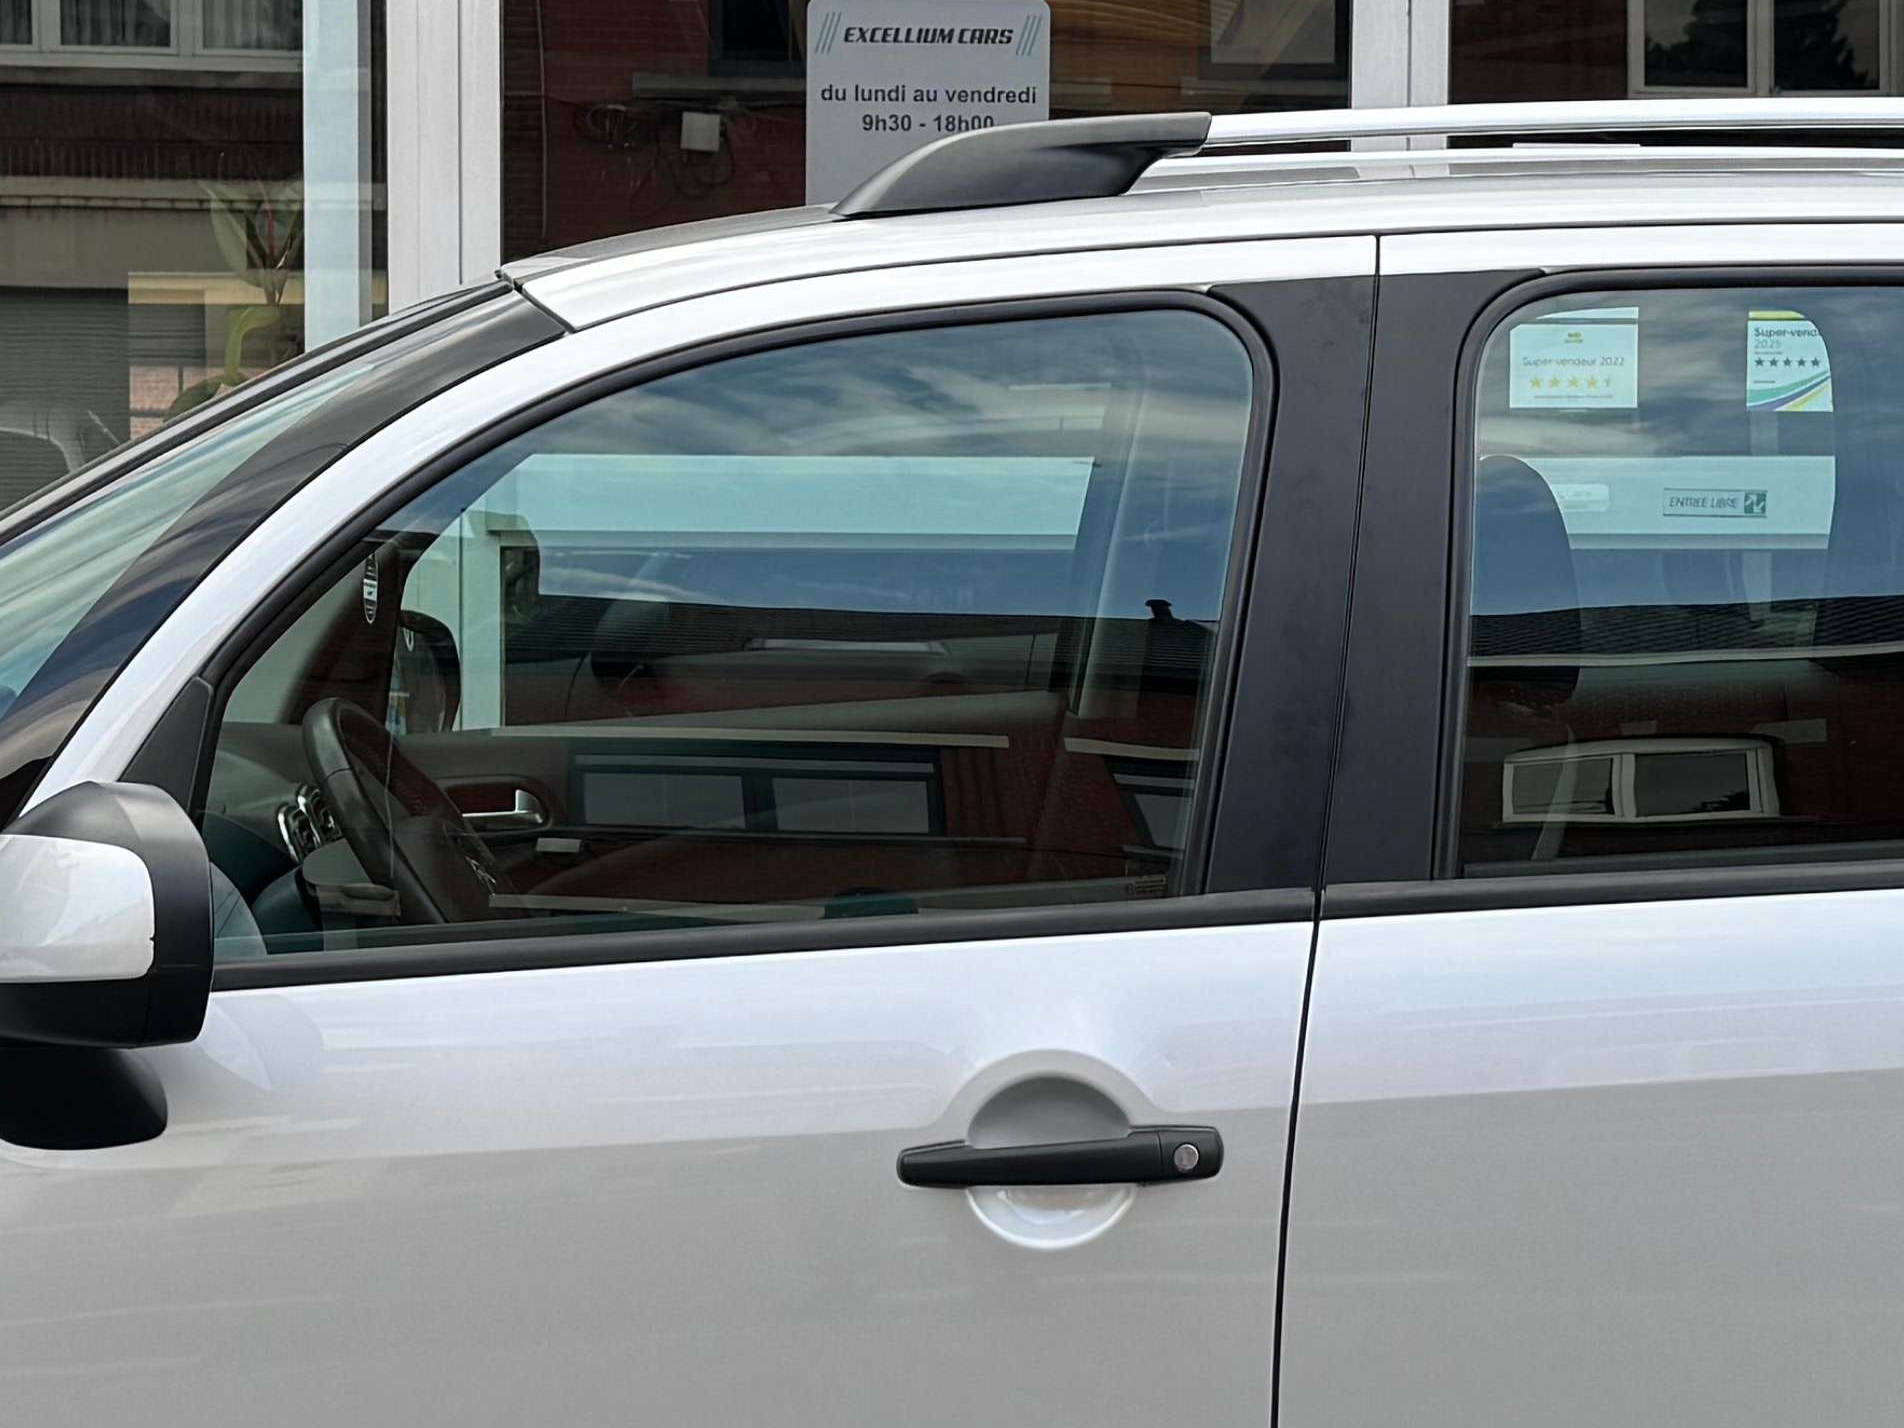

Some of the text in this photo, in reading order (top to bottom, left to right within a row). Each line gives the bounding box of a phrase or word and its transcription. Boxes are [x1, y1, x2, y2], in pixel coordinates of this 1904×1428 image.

[843, 26, 1014, 46] EXCELLIUM CARS
[820, 84, 1037, 104] du lundi au vendredi
[862, 114, 912, 132] 9h30
[934, 115, 995, 132] 18h00
